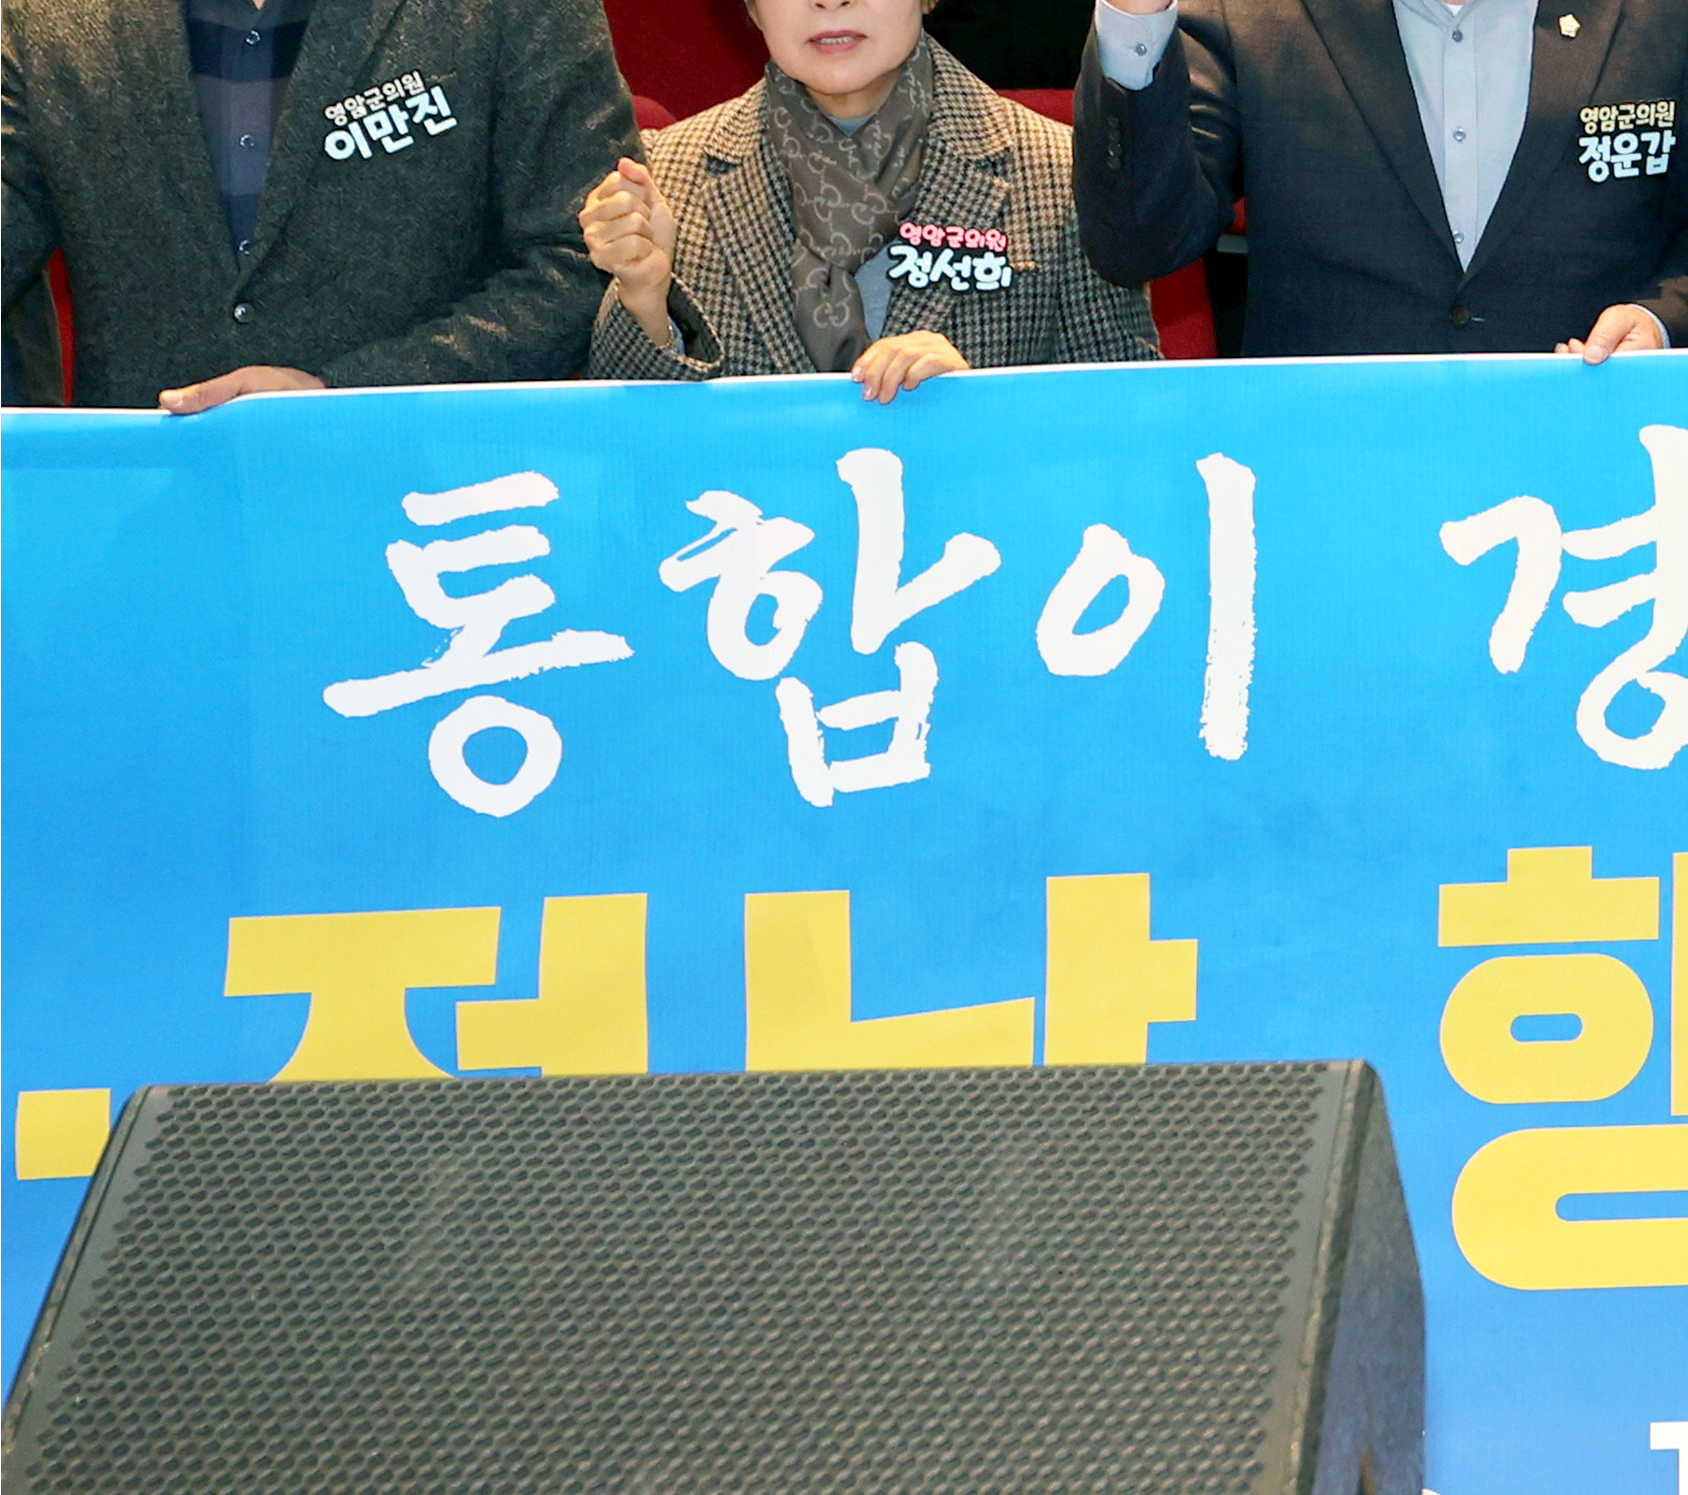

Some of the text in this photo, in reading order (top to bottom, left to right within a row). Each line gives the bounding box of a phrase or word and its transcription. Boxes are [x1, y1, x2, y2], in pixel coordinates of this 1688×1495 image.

[324, 70, 426, 127] 영암군의원
[324, 85, 458, 160] 이만진
[1579, 101, 1676, 135] 영암군의원
[1578, 129, 1677, 183] 정운갑
[899, 222, 1008, 253] 영암군의원
[888, 245, 1013, 291] 정선희
[324, 448, 1258, 818] 통합이
